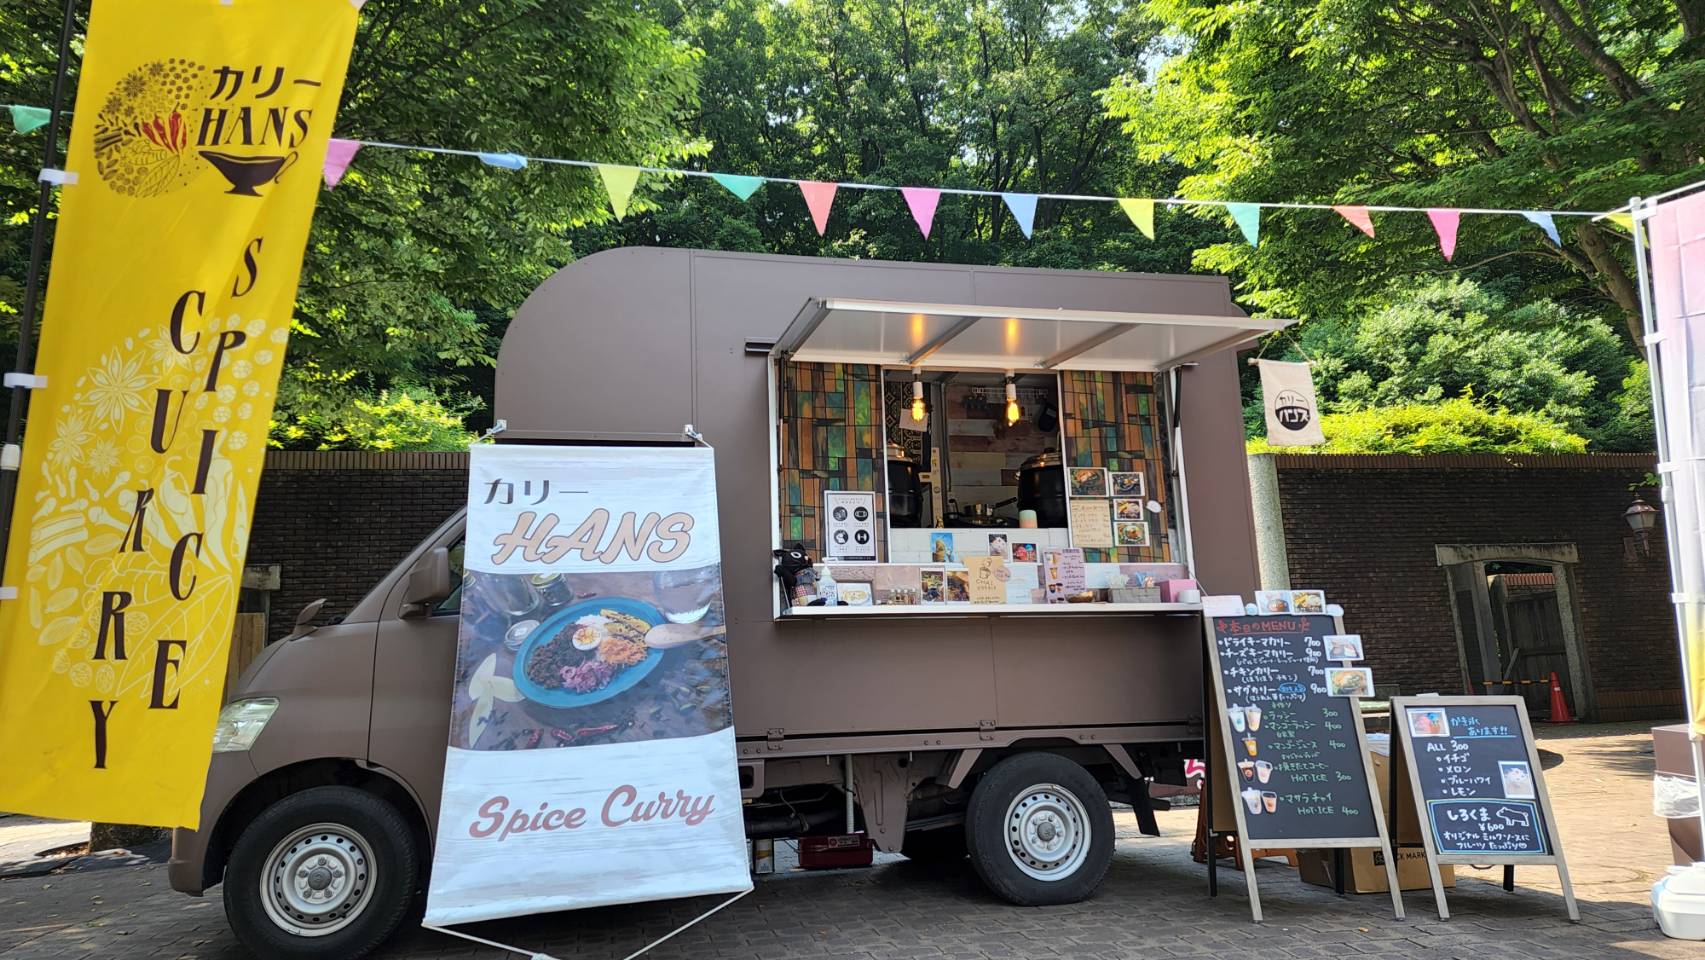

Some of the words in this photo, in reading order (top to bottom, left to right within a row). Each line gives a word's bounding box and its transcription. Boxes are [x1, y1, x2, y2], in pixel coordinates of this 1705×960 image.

[210, 66, 321, 100] カリー
[195, 106, 312, 148] HANS
[149, 237, 264, 710] SPICE
[484, 478, 589, 506] カリー
[88, 289, 206, 769] CURRY
[491, 508, 695, 565] HANS
[1427, 742, 1446, 751] ALL
[1450, 739, 1469, 751] 300
[468, 795, 586, 842] Spice
[600, 784, 715, 827] Curry
[1447, 807, 1491, 821] しろくま
